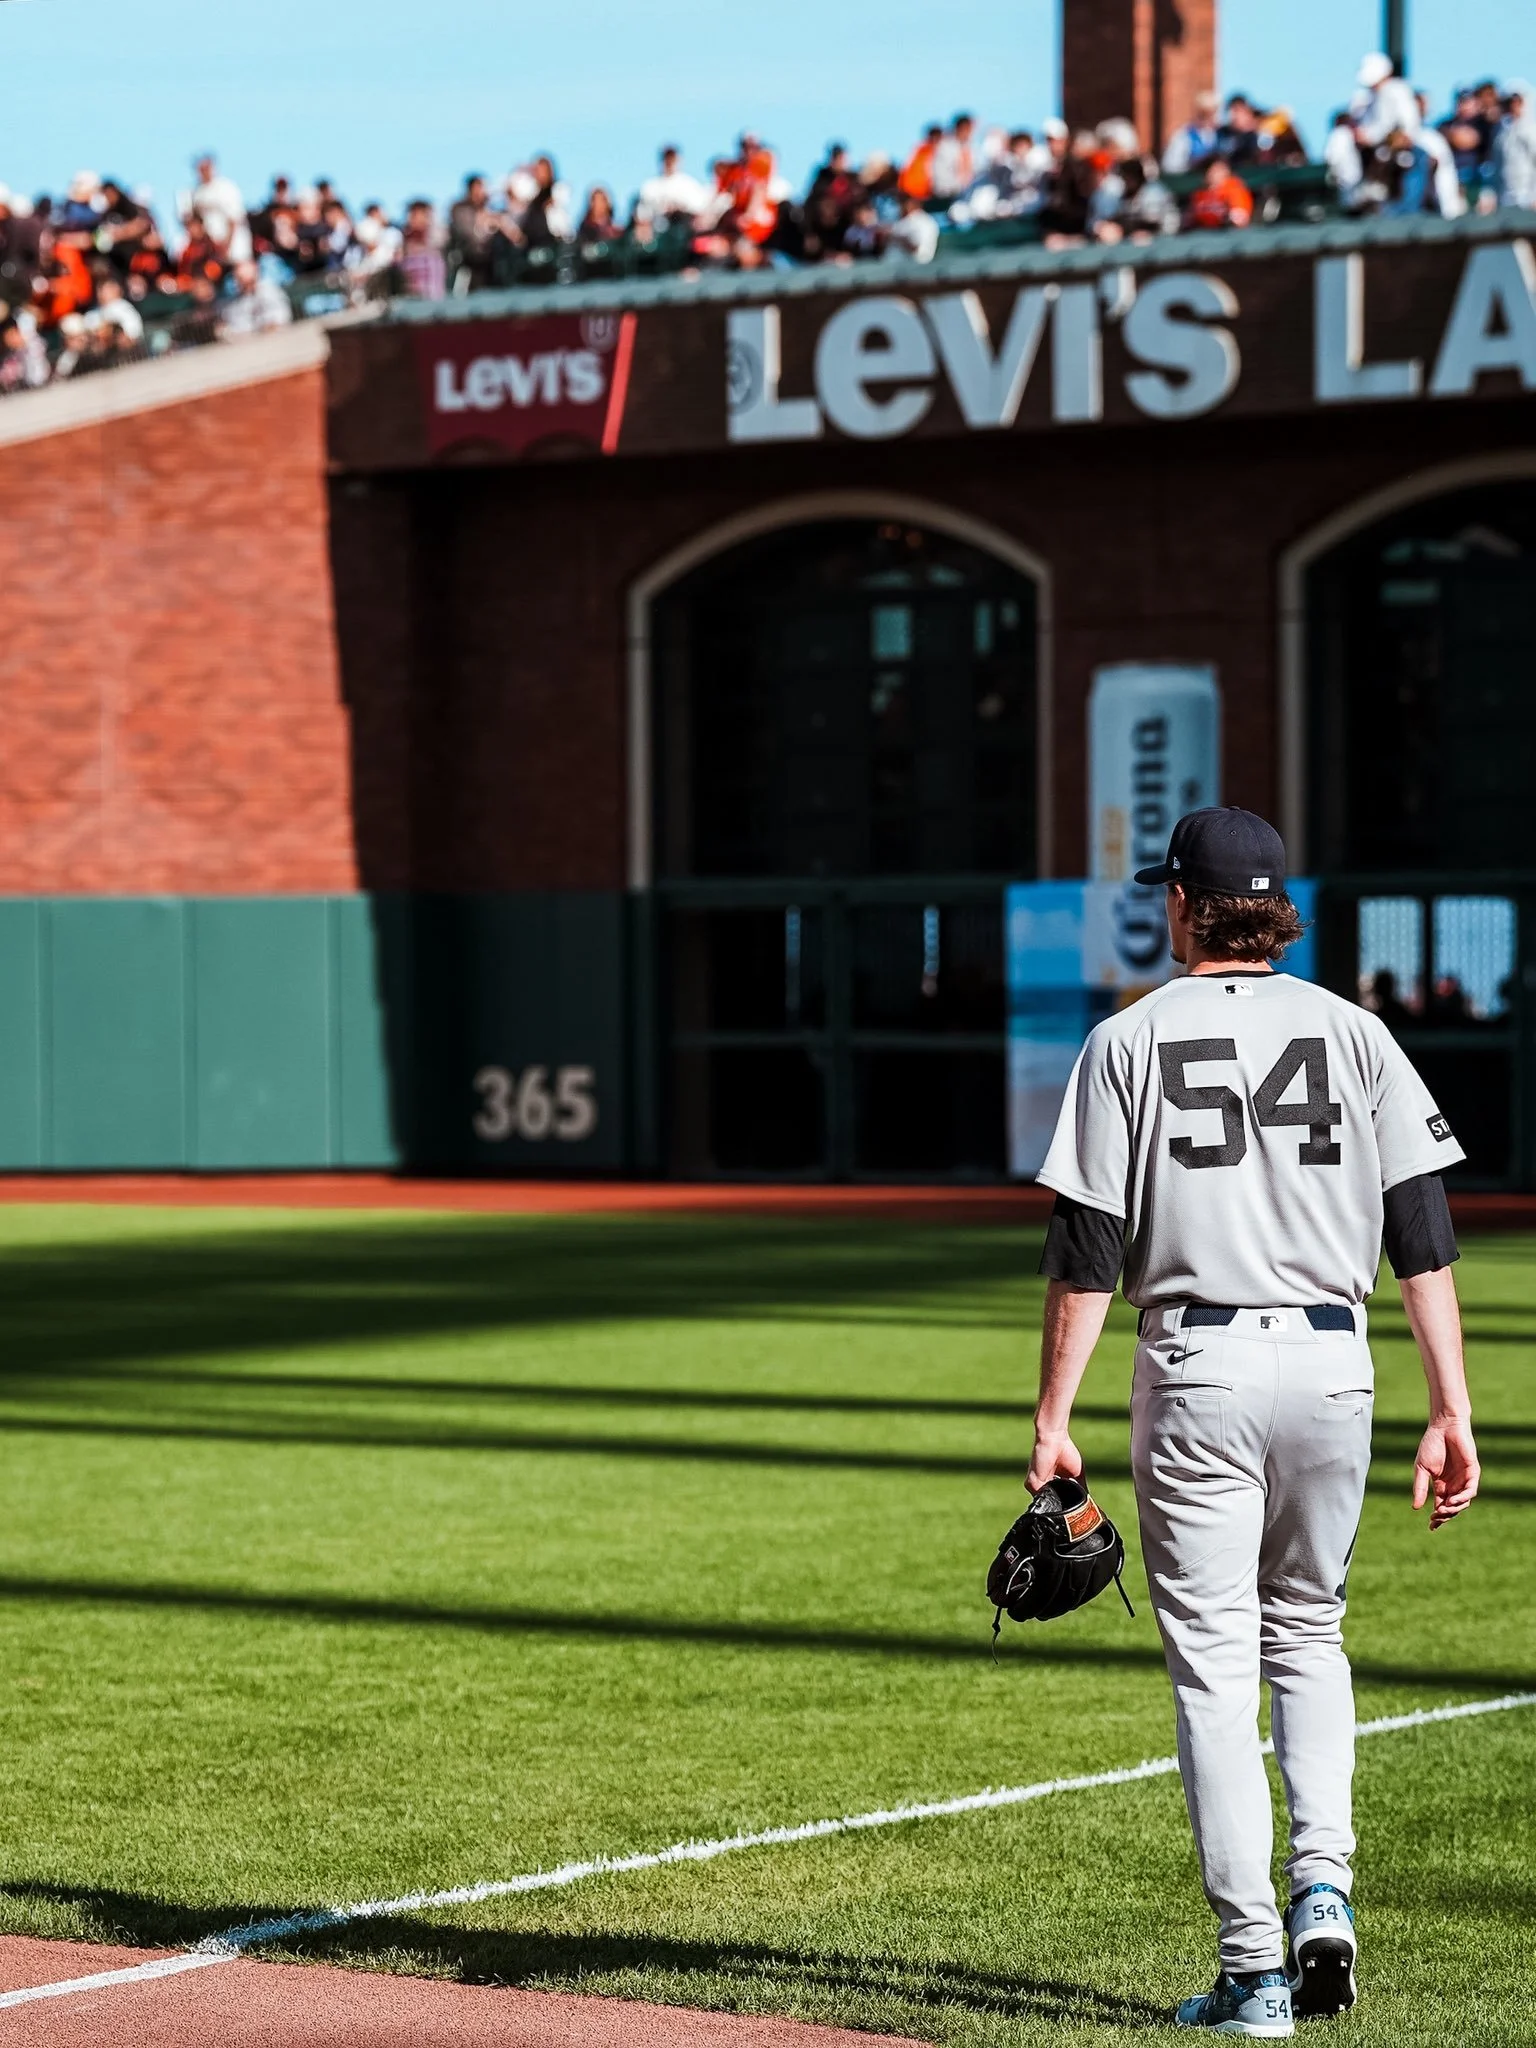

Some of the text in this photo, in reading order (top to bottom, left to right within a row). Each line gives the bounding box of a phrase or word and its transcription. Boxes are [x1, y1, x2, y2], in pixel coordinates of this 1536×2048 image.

[1313, 239, 1536, 403] LA
[472, 1065, 598, 1142] 365
[1157, 1038, 1341, 1169] 54
[1313, 1904, 1338, 1921] 54
[1266, 2000, 1288, 2018] 54
